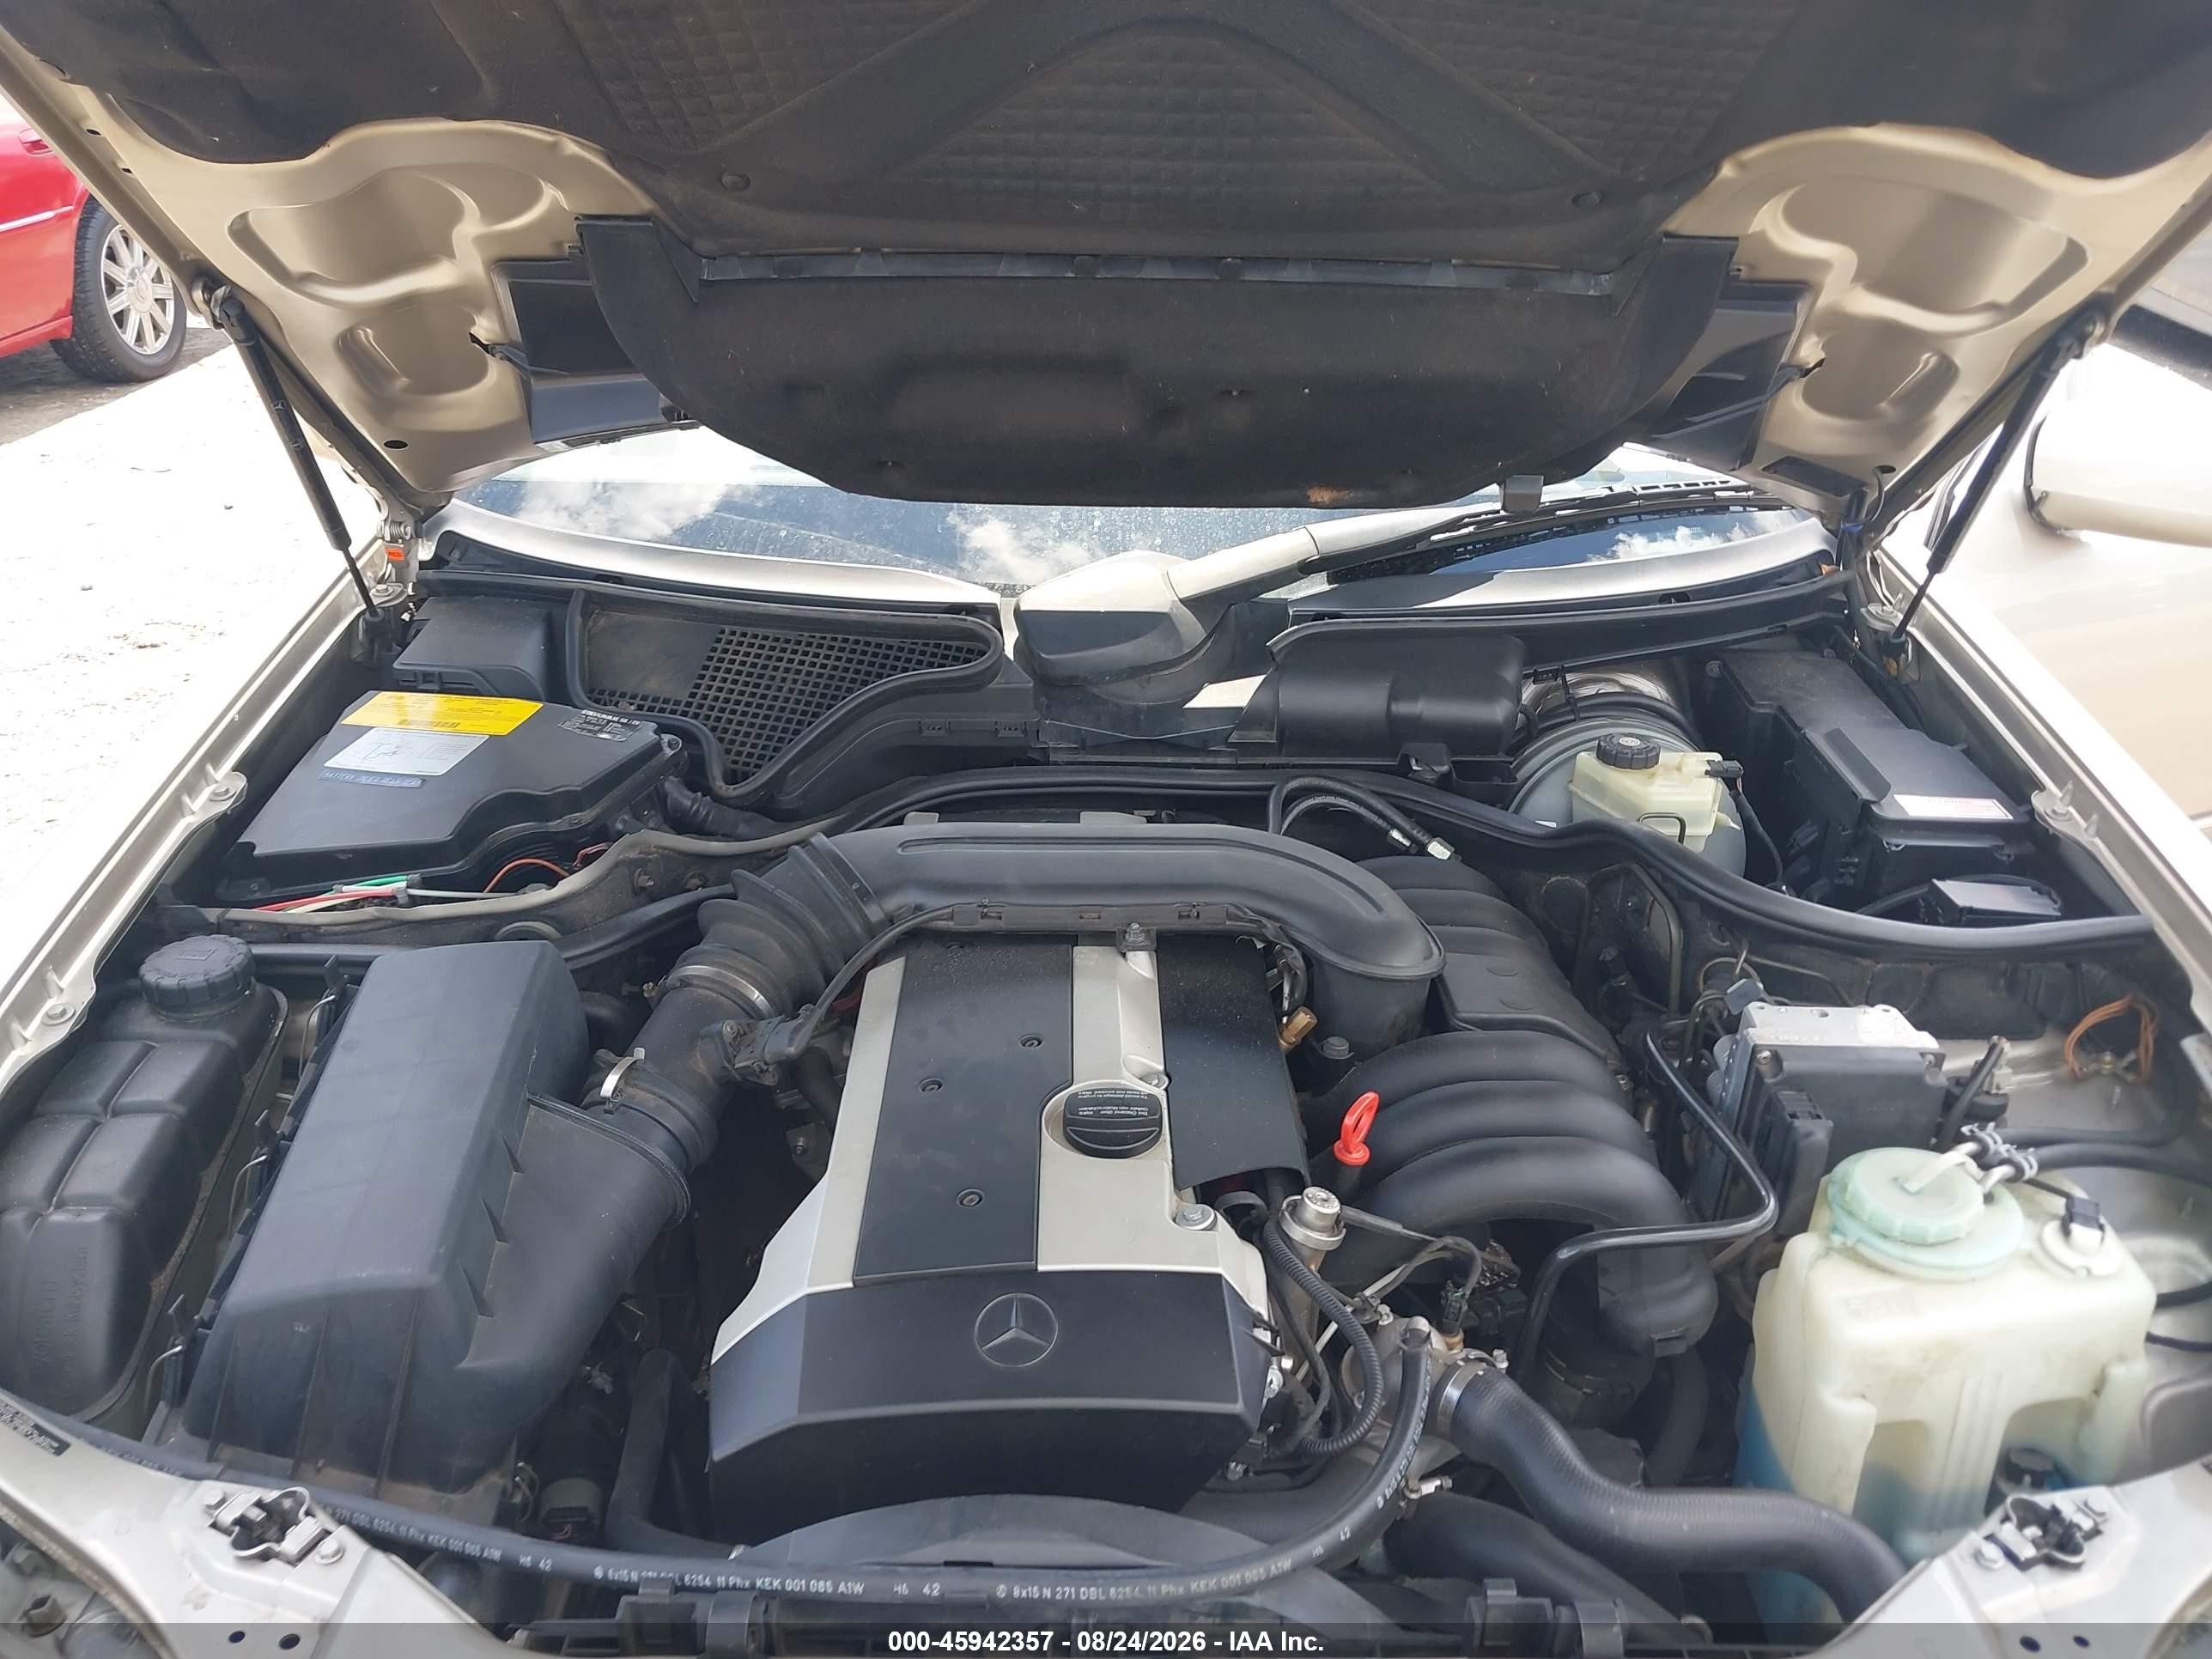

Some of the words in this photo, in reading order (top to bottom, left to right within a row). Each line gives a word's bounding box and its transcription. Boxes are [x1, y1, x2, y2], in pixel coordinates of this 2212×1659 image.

[755, 1577, 781, 1590] KEK
[784, 1578, 806, 1593] 001
[836, 1580, 866, 1595] A1W
[1054, 1586, 1075, 1601] 271
[1079, 1586, 1106, 1601] DBL
[1189, 1577, 1218, 1594] KEK
